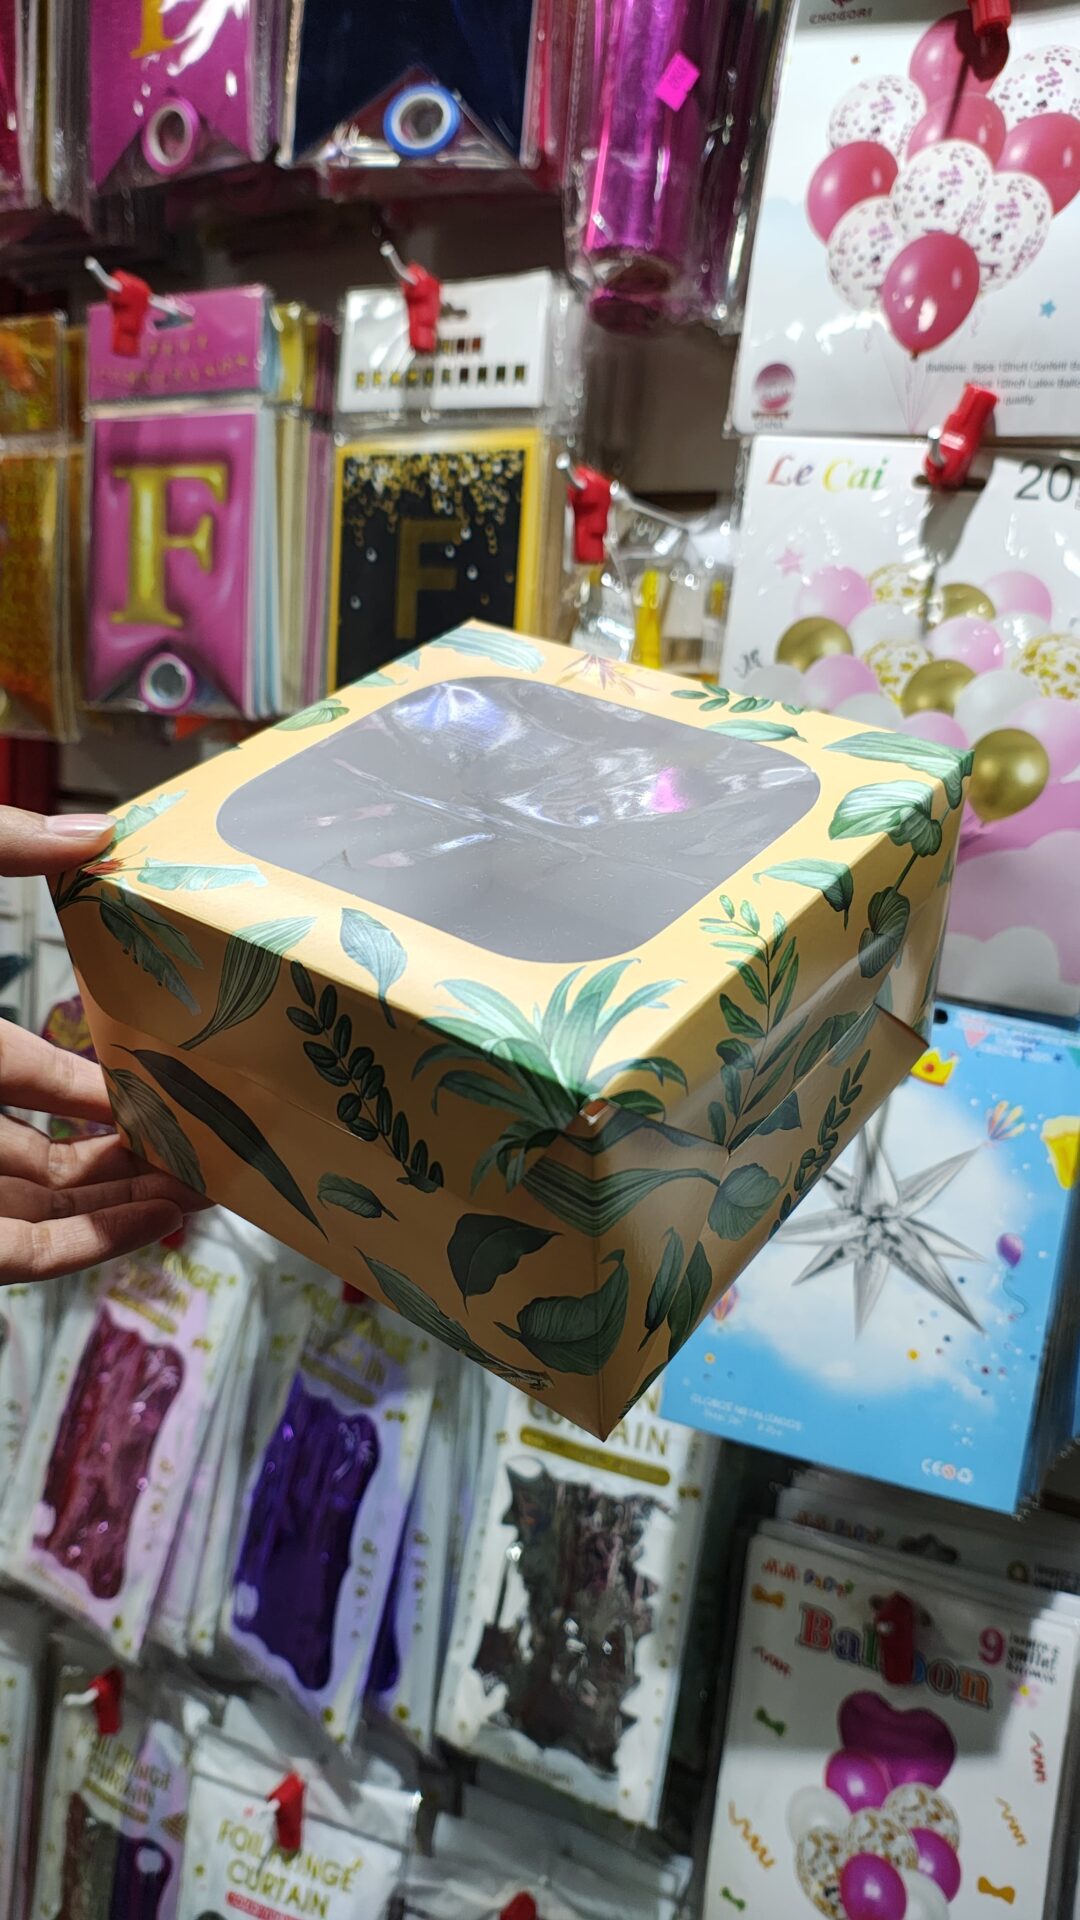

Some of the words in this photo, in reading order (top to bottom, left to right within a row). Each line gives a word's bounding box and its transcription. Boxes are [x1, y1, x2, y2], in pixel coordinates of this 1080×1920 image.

[767, 454, 814, 487] Le
[822, 457, 889, 492] Cai
[1014, 460, 1074, 503] 20
[111, 464, 228, 628] F
[394, 518, 463, 638] F
[528, 1397, 670, 1456] CUAIN
[979, 1626, 1004, 1665] 9
[217, 1818, 264, 1858] FOIL
[227, 1859, 331, 1918] CURTAIN
